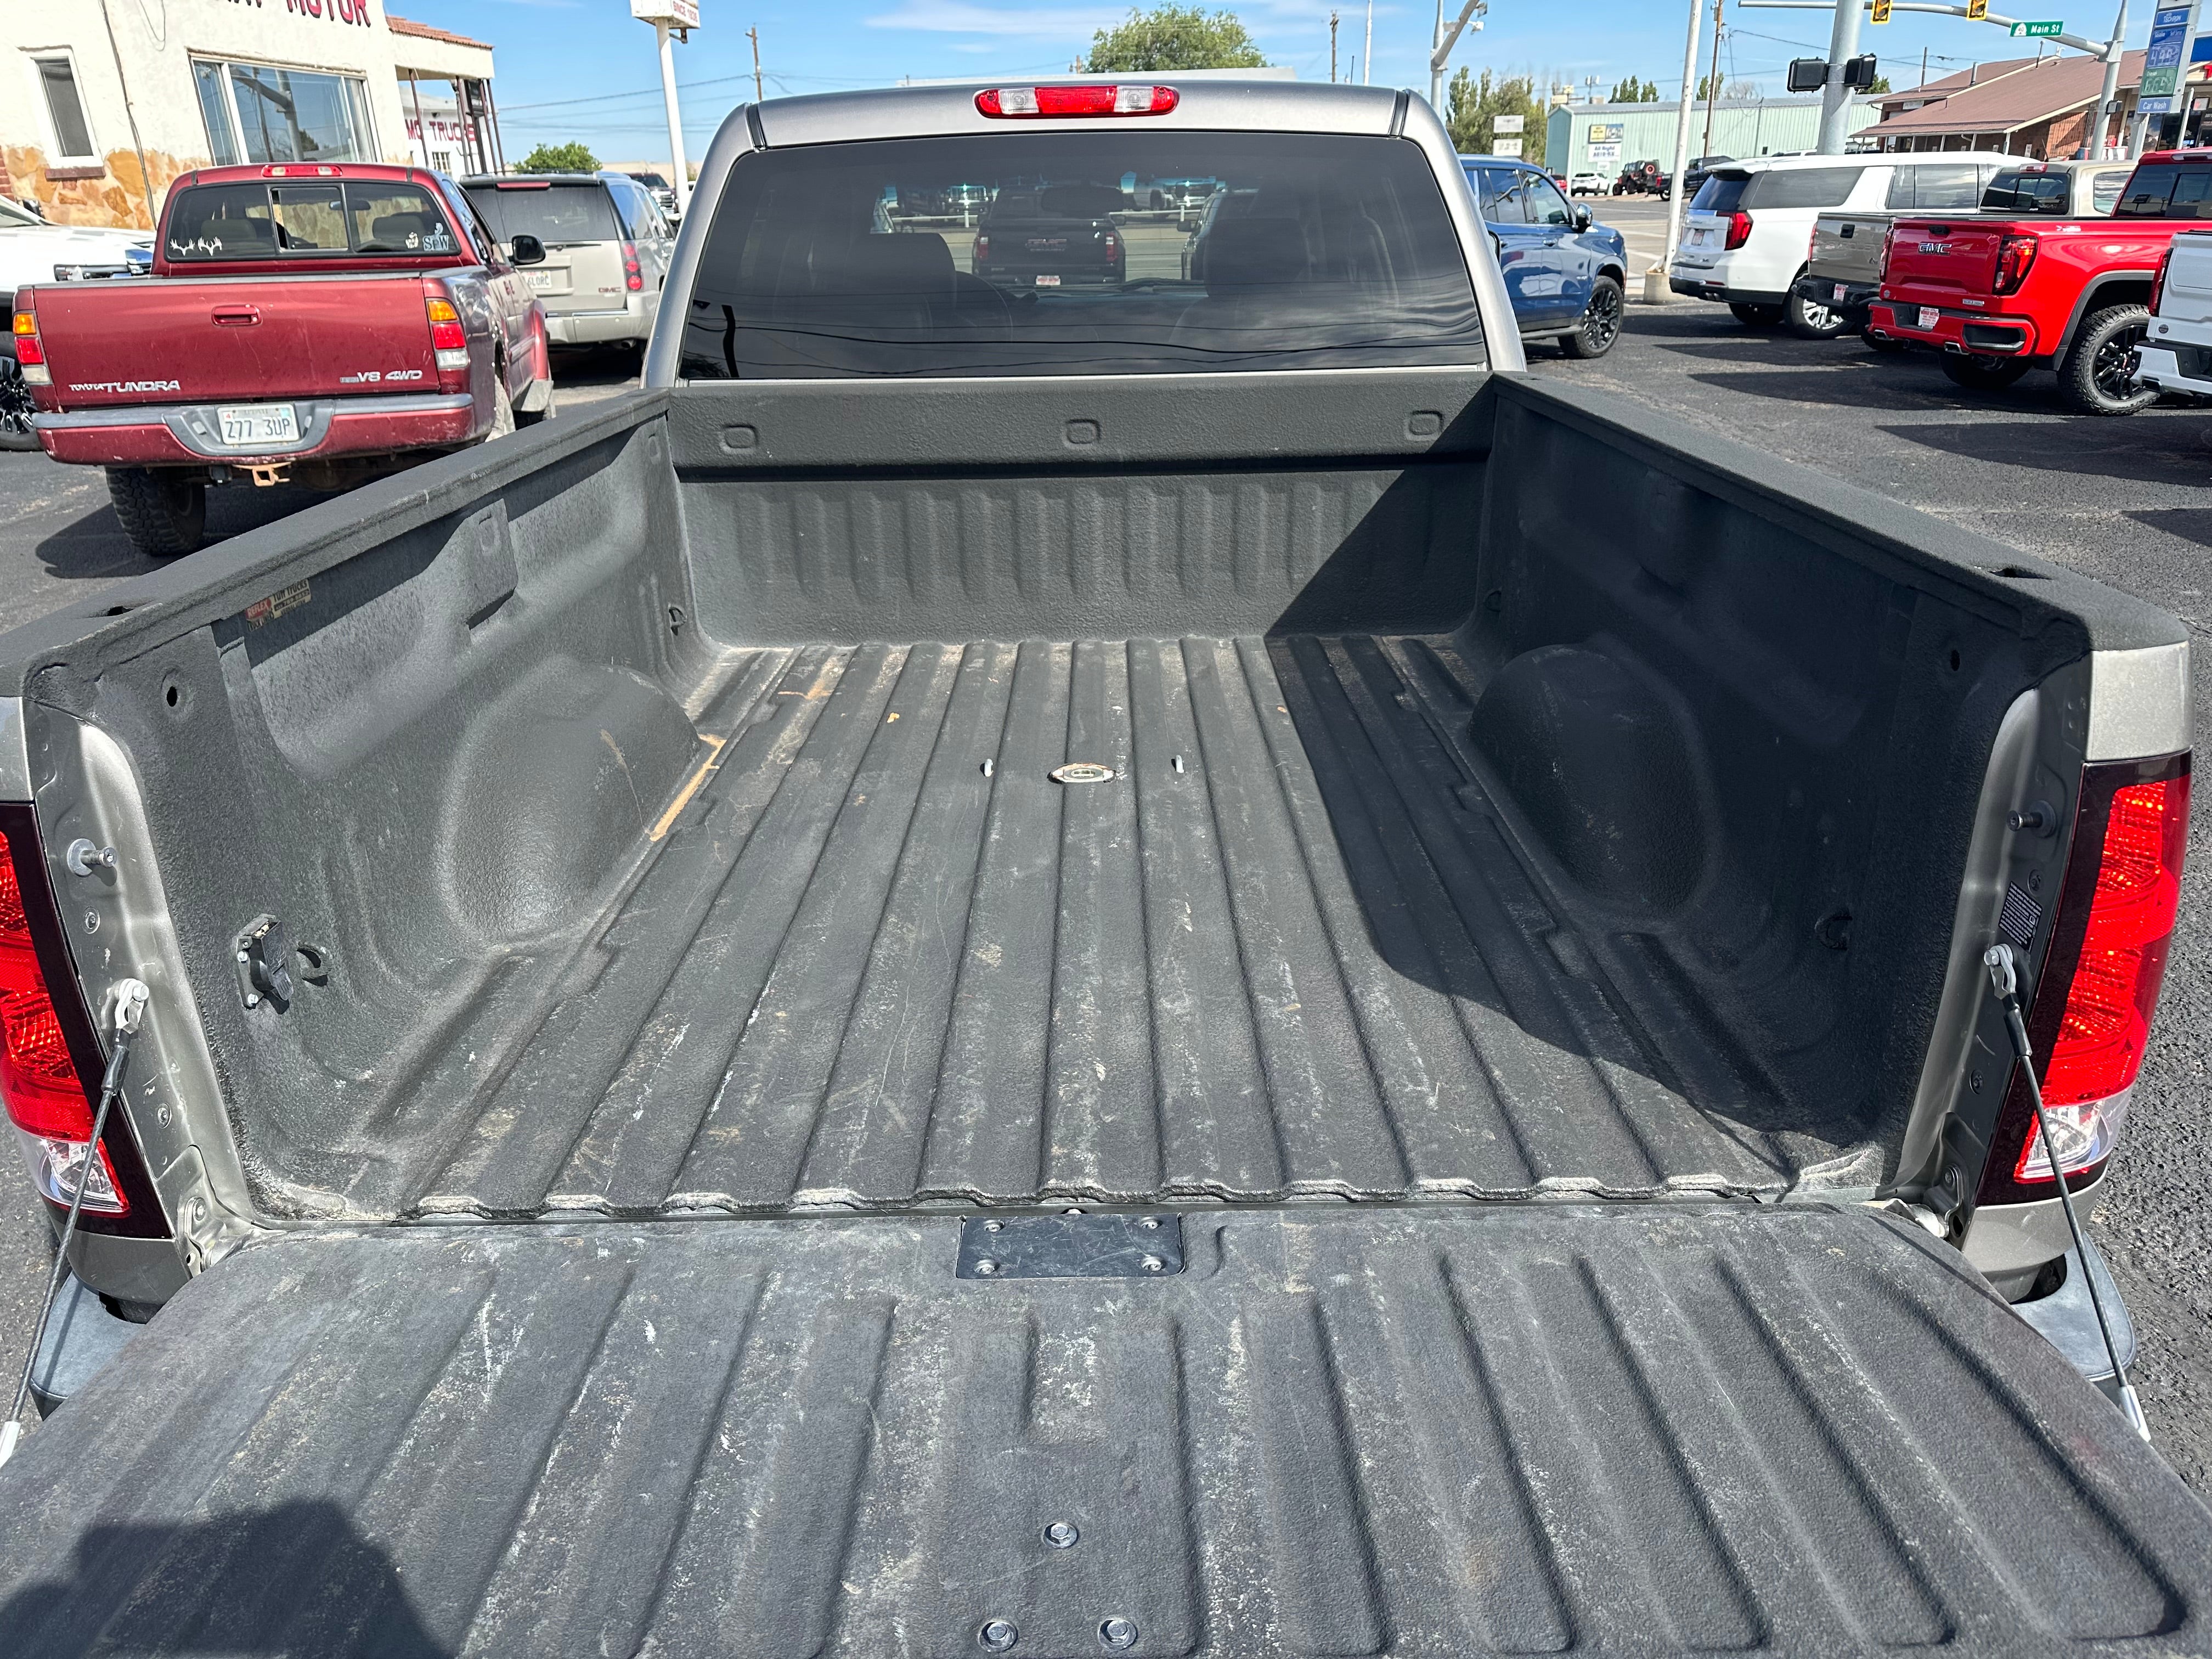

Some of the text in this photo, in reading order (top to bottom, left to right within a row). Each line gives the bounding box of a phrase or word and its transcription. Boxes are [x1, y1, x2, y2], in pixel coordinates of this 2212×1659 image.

[2031, 25, 2049, 33] Main
[2051, 24, 2060, 33] St
[2143, 101, 2166, 110] Car Wash
[1919, 242, 1952, 255] GMC
[357, 371, 381, 382] V8
[385, 370, 422, 381] 4WD
[103, 380, 181, 393] TUNDRA
[247, 599, 269, 619] REFLEX
